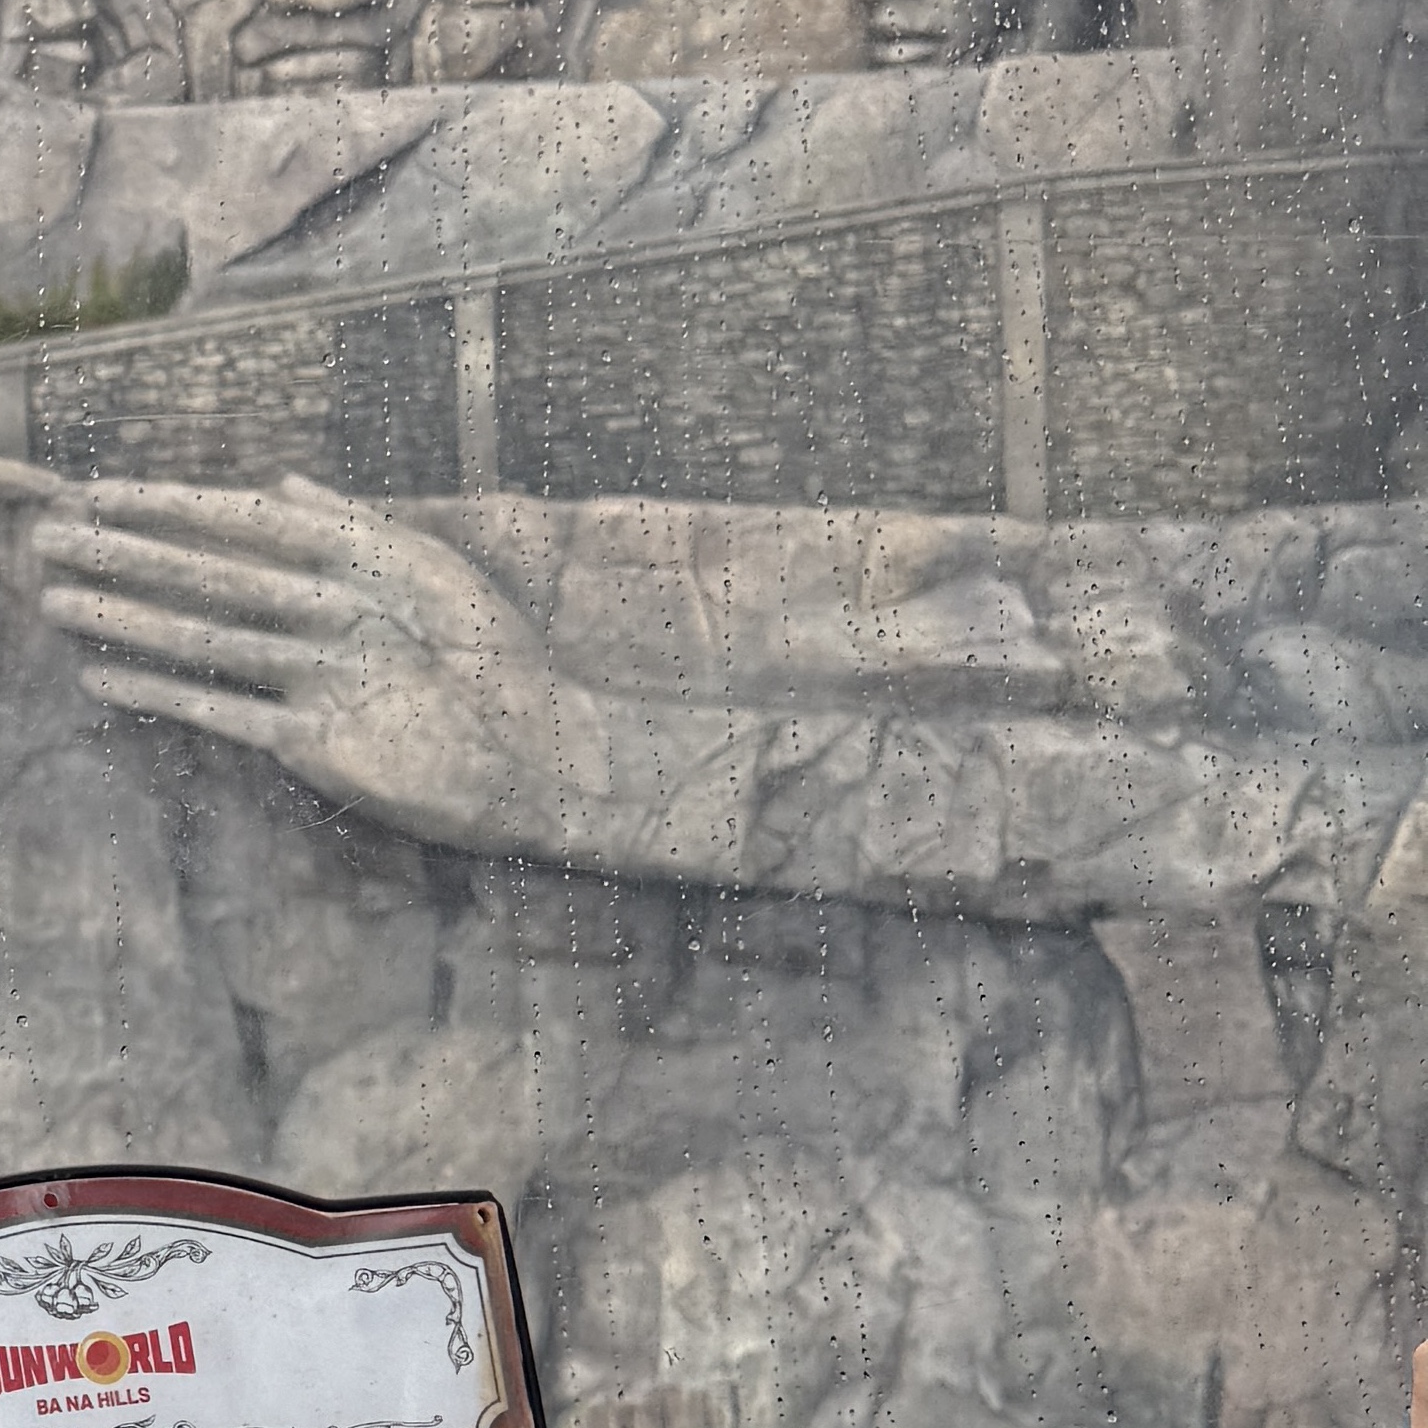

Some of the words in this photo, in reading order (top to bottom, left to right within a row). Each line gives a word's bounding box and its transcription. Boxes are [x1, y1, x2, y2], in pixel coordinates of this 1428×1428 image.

[36, 1397, 63, 1416] BA
[66, 1394, 94, 1412] NA
[97, 1387, 151, 1408] HILLS
